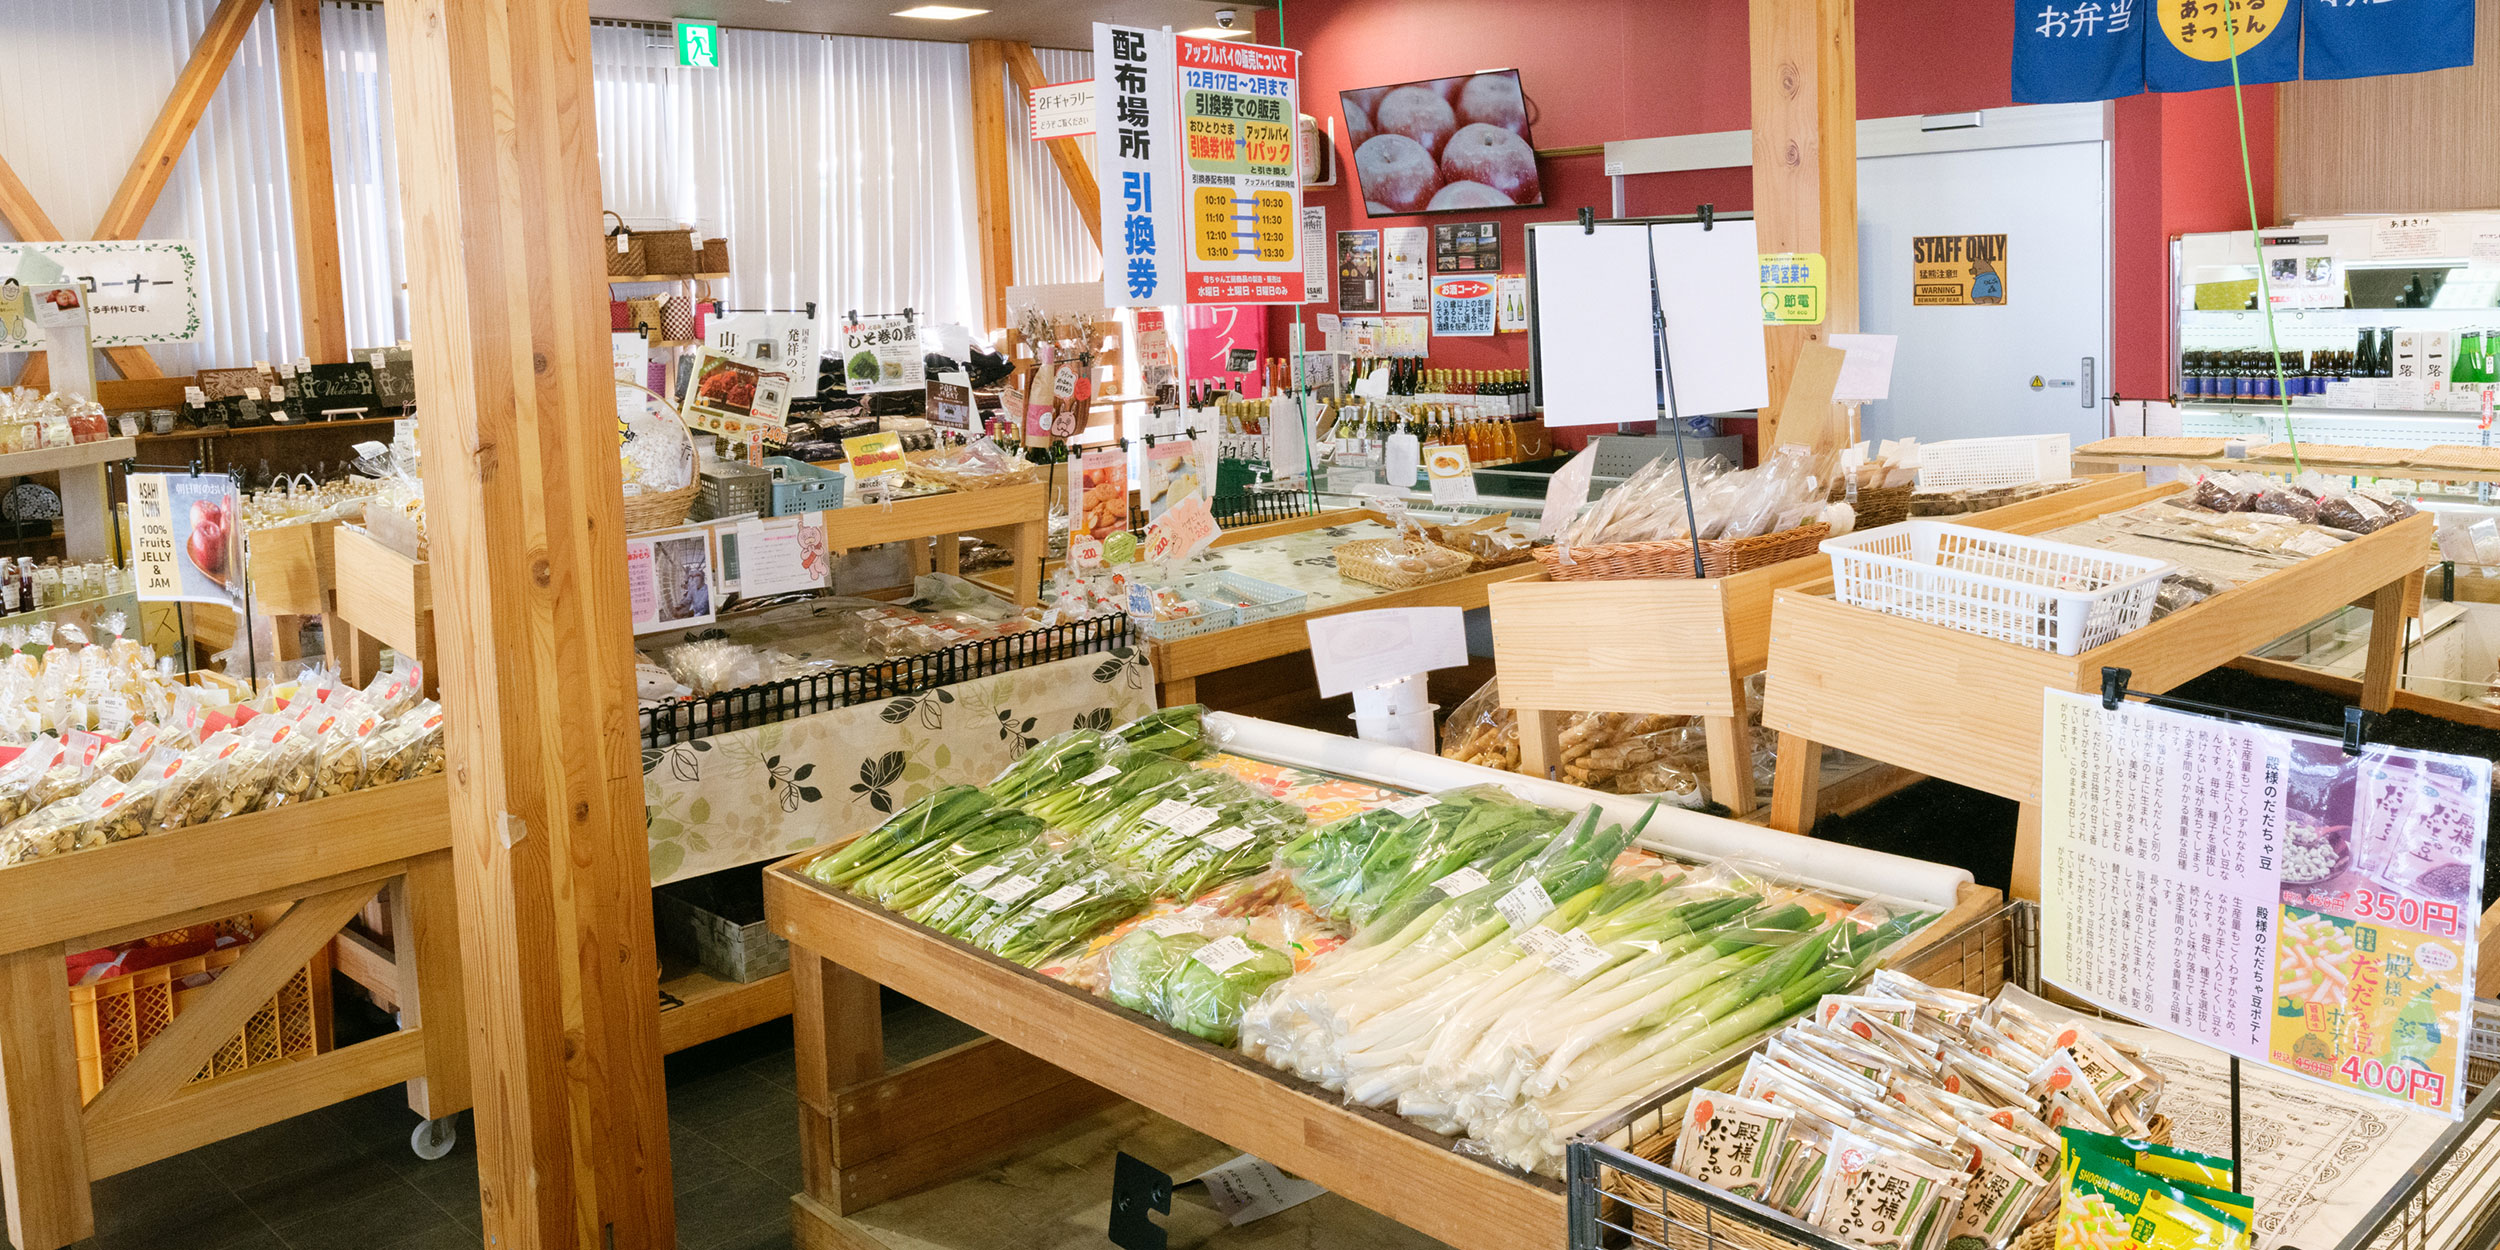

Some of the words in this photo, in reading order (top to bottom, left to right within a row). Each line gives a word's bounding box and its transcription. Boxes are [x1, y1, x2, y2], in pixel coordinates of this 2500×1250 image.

[2035, 0, 2134, 39] お弁当
[2180, 15, 2267, 43] きっちん
[1184, 42, 1287, 73] アップルパイの販売について
[1039, 91, 1094, 110] 2Fギャラリー
[1111, 29, 1150, 160] 配布場所
[1195, 93, 1280, 120] 引換券での販売
[1189, 120, 1235, 136] おひとりさま
[1246, 125, 1289, 142] アップルパイ
[1190, 134, 1235, 161] 引換券1枚
[1246, 141, 1290, 162] 1パック
[1192, 174, 1236, 186] 引換券配布時間
[1250, 166, 1287, 176] と引き換え
[1205, 195, 1226, 205] 10:10
[1262, 198, 1283, 208] 10:30
[1206, 213, 1224, 223] 11:10
[1262, 216, 1282, 225] 11:30
[1122, 171, 1158, 299] 引換券
[1206, 231, 1227, 241] 12:10
[1263, 232, 1284, 242] 12:30
[1207, 247, 1228, 257] 13:10
[1264, 248, 1284, 258] 13:30
[1913, 236, 1962, 263] STAFF
[1966, 235, 2006, 262] ONLY
[1760, 263, 1809, 284] 節電営業中
[1198, 286, 1288, 297] 水曜日・土曜日・日曜日のみ
[1441, 283, 1488, 296] お酒コーナー
[1784, 294, 1809, 308] 節電
[1921, 286, 1956, 296] WARNING
[88, 304, 150, 314] る手作りです。
[849, 325, 916, 349] しそ巻の素
[786, 328, 799, 376] 発祥の
[139, 482, 160, 500] ASAHI
[141, 500, 161, 518] TOWN
[141, 525, 167, 535] 100%
[140, 537, 171, 549] Fruits
[1082, 548, 1097, 560] 200
[1154, 537, 1168, 556] 200
[141, 551, 171, 563] JELLY
[153, 565, 161, 575] &
[149, 577, 170, 588] JAM
[2177, 727, 2194, 870] 大変手間のかかる貴重な品種
[2259, 755, 2280, 871] 殿様のだだちゃ豆
[1533, 885, 1546, 900] ¥250
[2163, 878, 2172, 905] です。
[2353, 889, 2460, 936] 350円
[2170, 881, 2186, 1024] 大変手間のかかる貴重な品種
[2184, 884, 2199, 1027] 続けないと味が落ちてしまう
[2197, 889, 2213, 1033] んです。毎年、種子を選抜し
[2211, 893, 2228, 1037] なかなか手に入りにくい豆な
[2225, 896, 2243, 1037] 生産量もごくわずかなため、
[2249, 906, 2269, 1045] 殿様のだだちゃ豆ポテト
[2384, 952, 2414, 1007] 殿様の
[2349, 954, 2381, 1056] だだちゃ豆
[2273, 1050, 2291, 1064] 税込
[2295, 1057, 2333, 1078] 450円
[2341, 1055, 2445, 1107] 400円
[1728, 1121, 1761, 1178] 殿様の
[2078, 1168, 2110, 1192] SHOGUN
[1871, 1176, 1910, 1235] 殿様の
[1967, 1173, 2010, 1228] 殿様の
